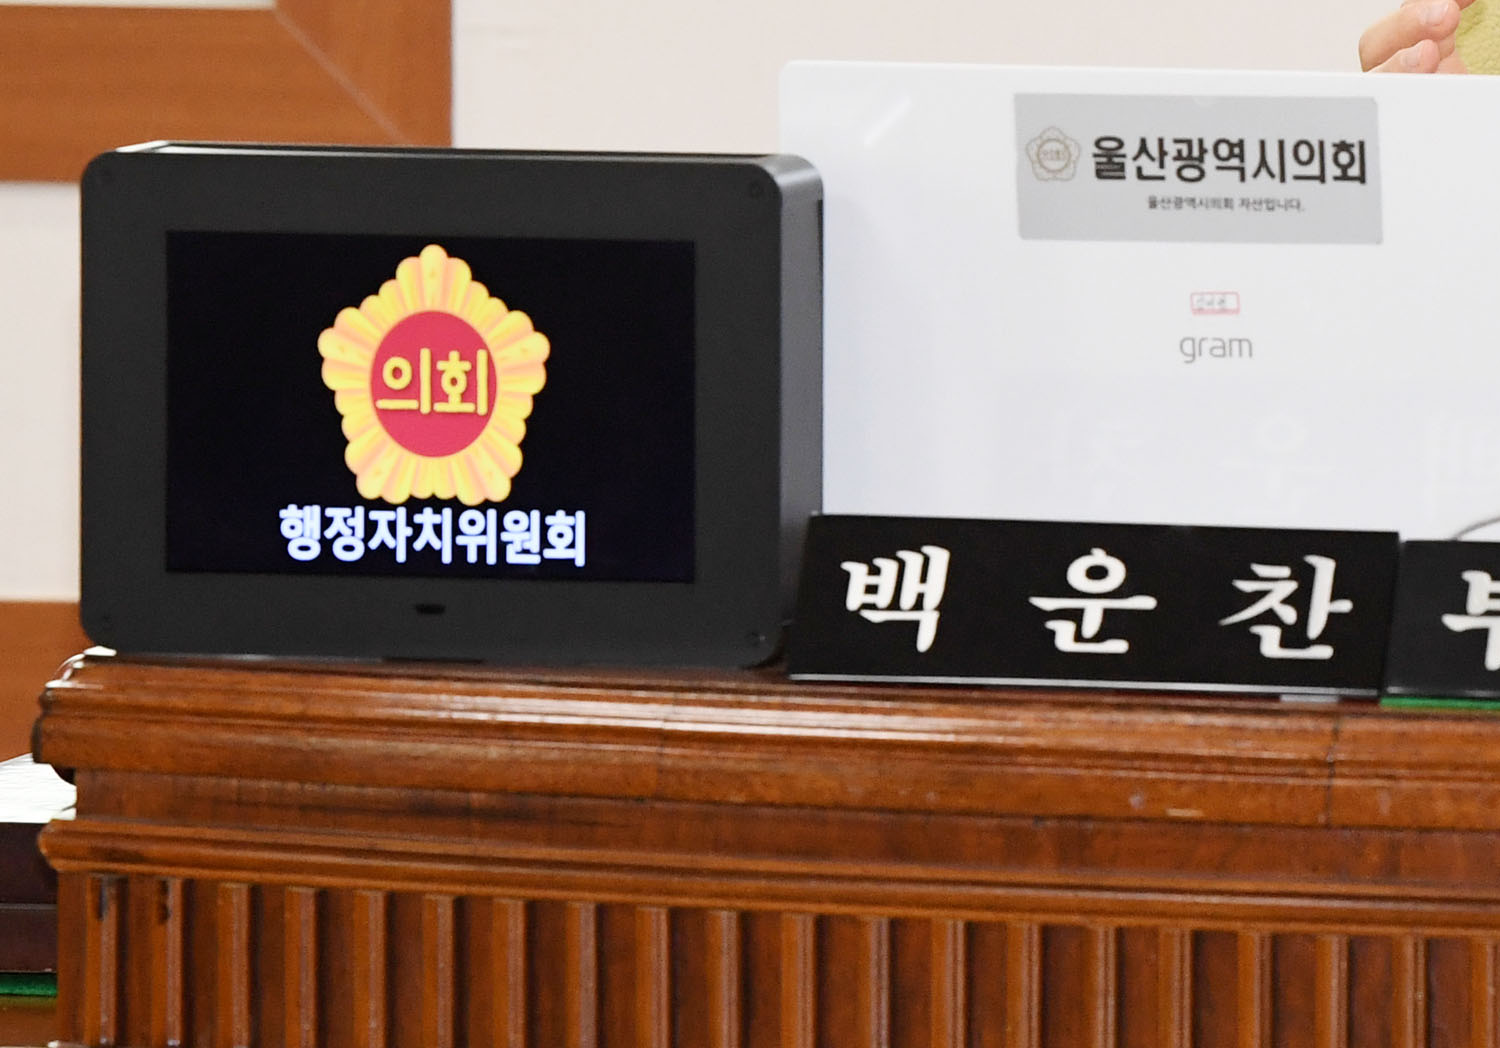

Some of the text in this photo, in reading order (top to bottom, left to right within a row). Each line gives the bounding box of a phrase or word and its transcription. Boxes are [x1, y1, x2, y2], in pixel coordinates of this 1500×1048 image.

[1092, 136, 1367, 185] 울산광역시의회
[1147, 196, 1235, 211] 울산광역시의회
[1179, 336, 1253, 363] gram
[376, 348, 488, 415] 의회
[279, 504, 586, 568] 행정자치위원회
